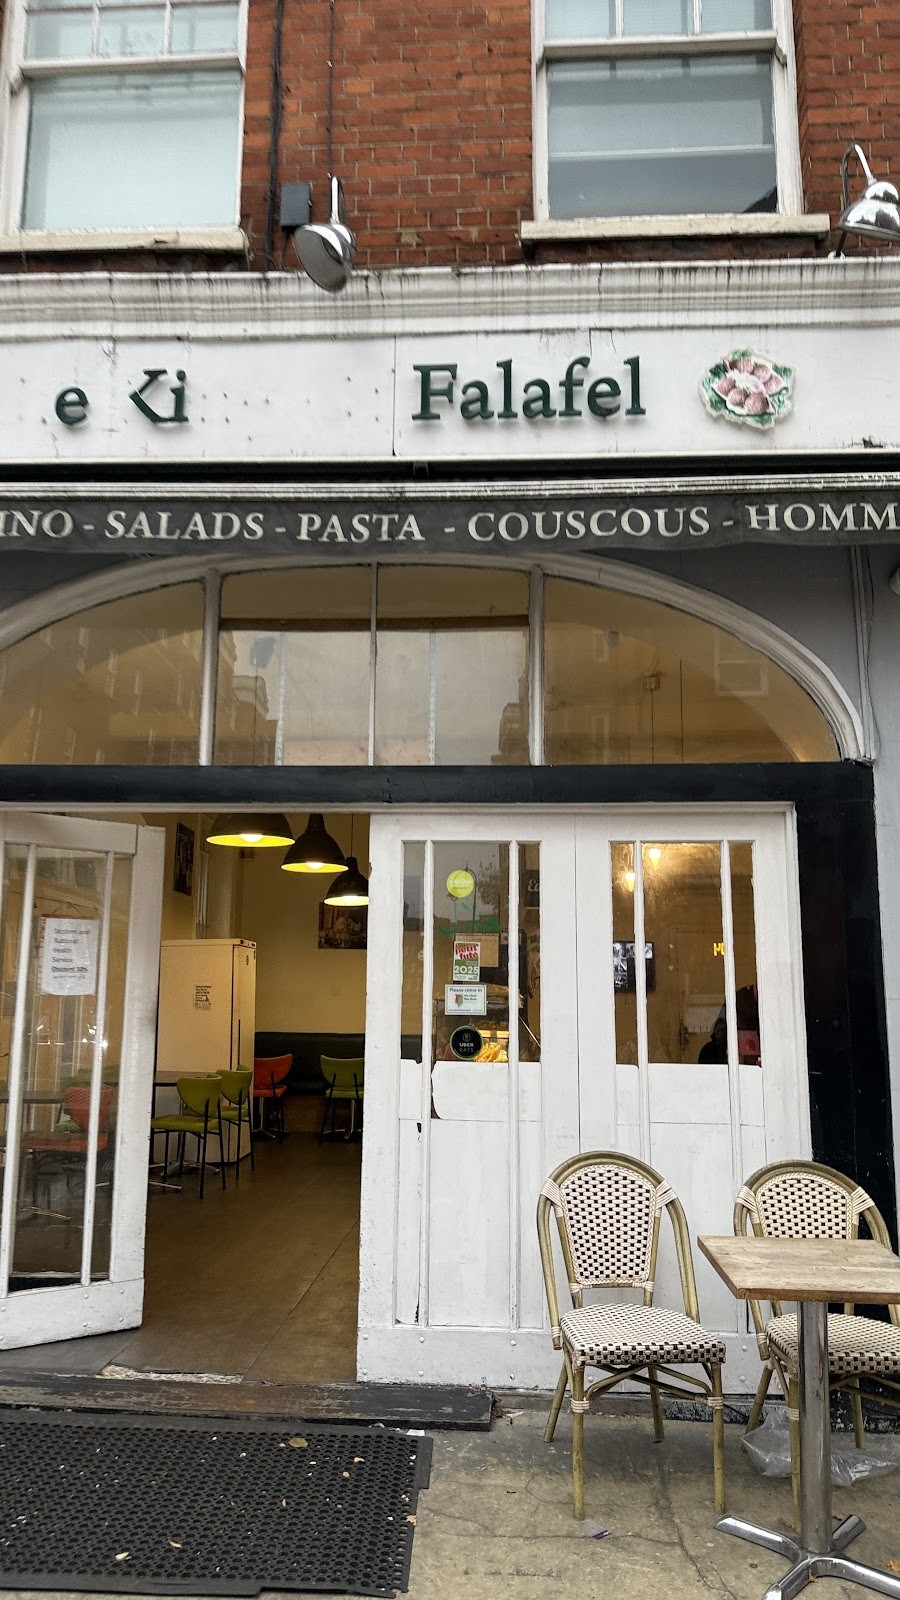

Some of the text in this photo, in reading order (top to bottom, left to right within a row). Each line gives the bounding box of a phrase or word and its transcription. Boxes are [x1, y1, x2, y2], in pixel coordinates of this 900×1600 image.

[411, 356, 646, 420] Falafel
[105, 510, 264, 540] SALADS
[296, 513, 425, 543] PASTA
[467, 505, 710, 541] COUSCOUS
[455, 944, 478, 956] petit
[454, 964, 479, 974] 2025
